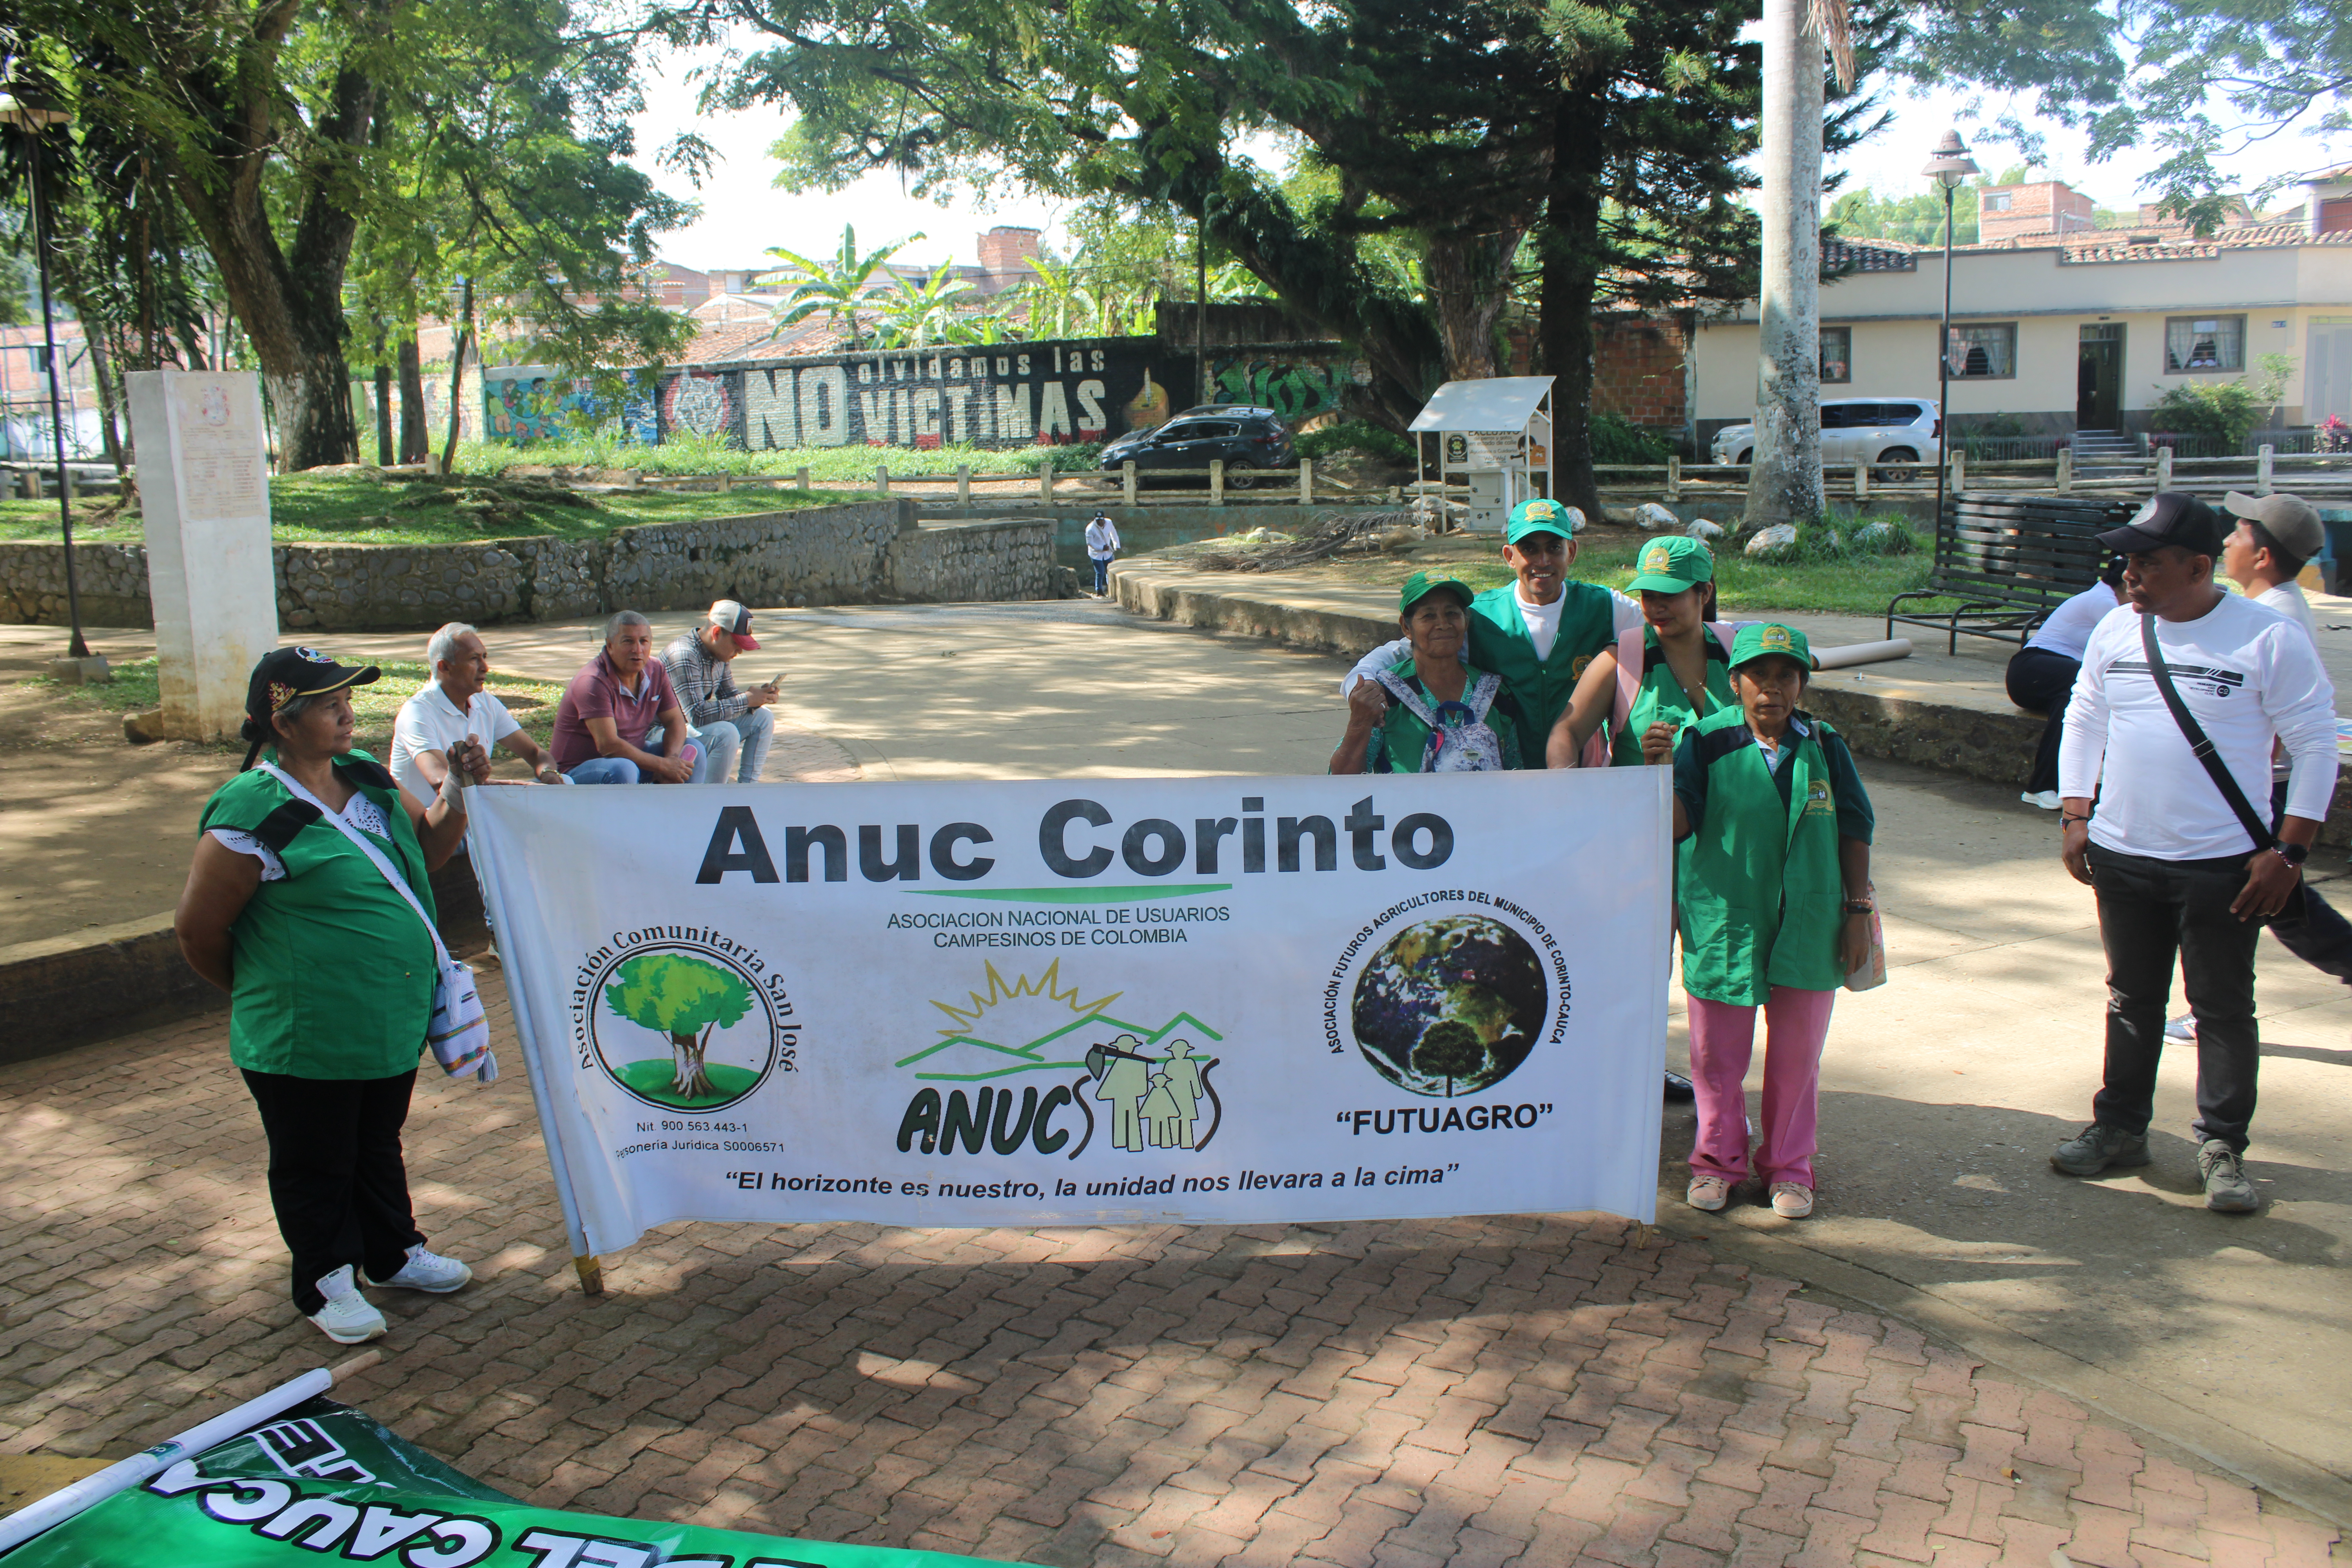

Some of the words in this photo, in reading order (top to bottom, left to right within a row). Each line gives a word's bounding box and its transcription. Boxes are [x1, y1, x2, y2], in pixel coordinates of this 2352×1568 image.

[858, 353, 1031, 385] olvidamos
[1054, 346, 1105, 374] las
[745, 365, 848, 450] NO
[859, 379, 1107, 450] VICTIMAS
[695, 806, 996, 885] Anuc
[1038, 795, 1455, 880] Corinto
[887, 912, 1003, 929] ASOCIACION
[1008, 909, 1102, 927] NACIONAL
[1106, 909, 1131, 924] DE
[1136, 906, 1230, 923] USUARIOS
[1372, 889, 1465, 930] AGRICULTORES
[1468, 890, 1491, 906] DEL
[1493, 896, 1546, 935] MUNICIPIO
[613, 925, 765, 975] Comunitaria
[933, 931, 1056, 948] CAMPESINOS
[1061, 931, 1086, 946] DE
[1091, 928, 1188, 946] COLOMBIA
[1331, 926, 1374, 979] FUTUROS
[1541, 933, 1558, 950] DE
[569, 946, 614, 1070] Asociación
[762, 973, 793, 1018] San
[1323, 969, 1345, 1054] ASOCIACIÓN
[1549, 949, 1572, 1044] CORINTO-CAUCA
[776, 1024, 802, 1073] José
[636, 1122, 657, 1132] Nit.
[661, 1120, 747, 1133] 900.563.443-1
[896, 1085, 1072, 1156] ANUC
[1336, 1103, 1553, 1136] “FUTUAGRO”
[615, 1139, 668, 1161] Personería
[671, 1139, 719, 1151] Jurídica
[771, 1172, 893, 1195] horizonte
[900, 1181, 930, 1197] es
[938, 1179, 1045, 1201] nuestro,
[1054, 1178, 1077, 1197] la
[1085, 1174, 1176, 1196] unidad
[1182, 1176, 1230, 1193] nos
[1238, 1170, 1323, 1191] llevara
[1331, 1172, 1346, 1188] a
[1354, 1166, 1376, 1187] la
[1384, 1163, 1460, 1186] cima”
[141, 1457, 501, 1568] CAUCA
